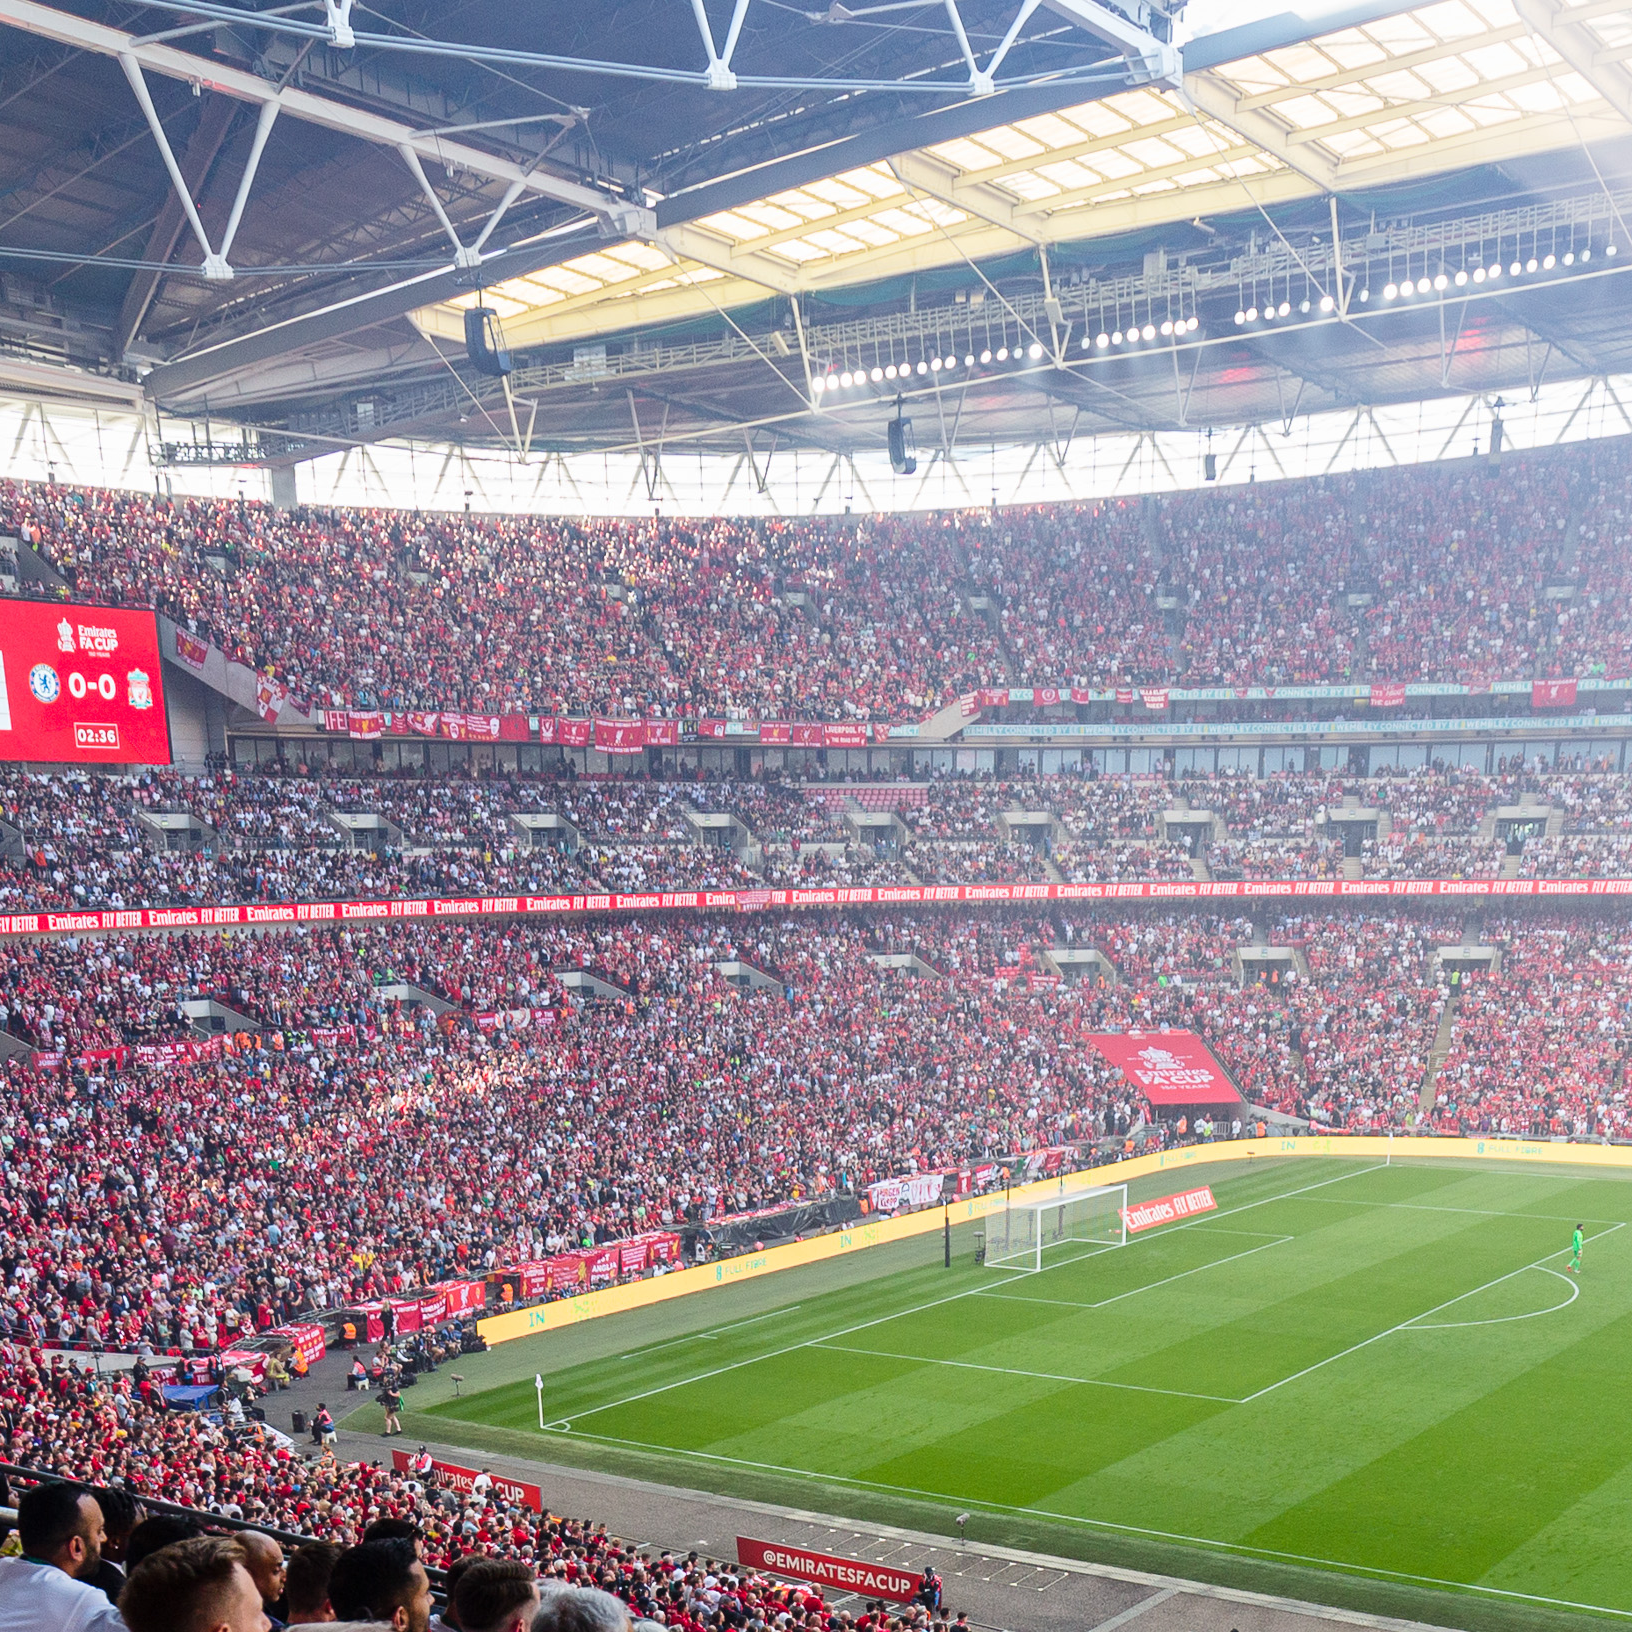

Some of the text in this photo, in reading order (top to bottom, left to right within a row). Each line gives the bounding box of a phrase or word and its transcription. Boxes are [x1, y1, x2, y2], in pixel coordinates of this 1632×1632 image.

[78, 624, 117, 639] Emirates
[79, 637, 118, 651] FA CUP
[68, 671, 117, 700] 0-0
[824, 724, 866, 734] LIVERPOOL FC
[1209, 723, 1330, 733] WEMBLEY CONNECTED BY EE
[78, 728, 116, 744] 02:36
[434, 897, 518, 915] Emirates FLY BETTER
[149, 907, 240, 927] Emirates FLY BETTER
[1133, 1068, 1210, 1078] Emirates
[1139, 1074, 1215, 1085] FA CUP
[1124, 1189, 1214, 1229] Emirates FLY BETTER
[840, 1234, 852, 1248] IN
[725, 1264, 743, 1275] FULL
[529, 1310, 545, 1328] IN
[495, 1481, 525, 1503] CUP
[763, 1550, 911, 1595] @EMIRATESFACUP
